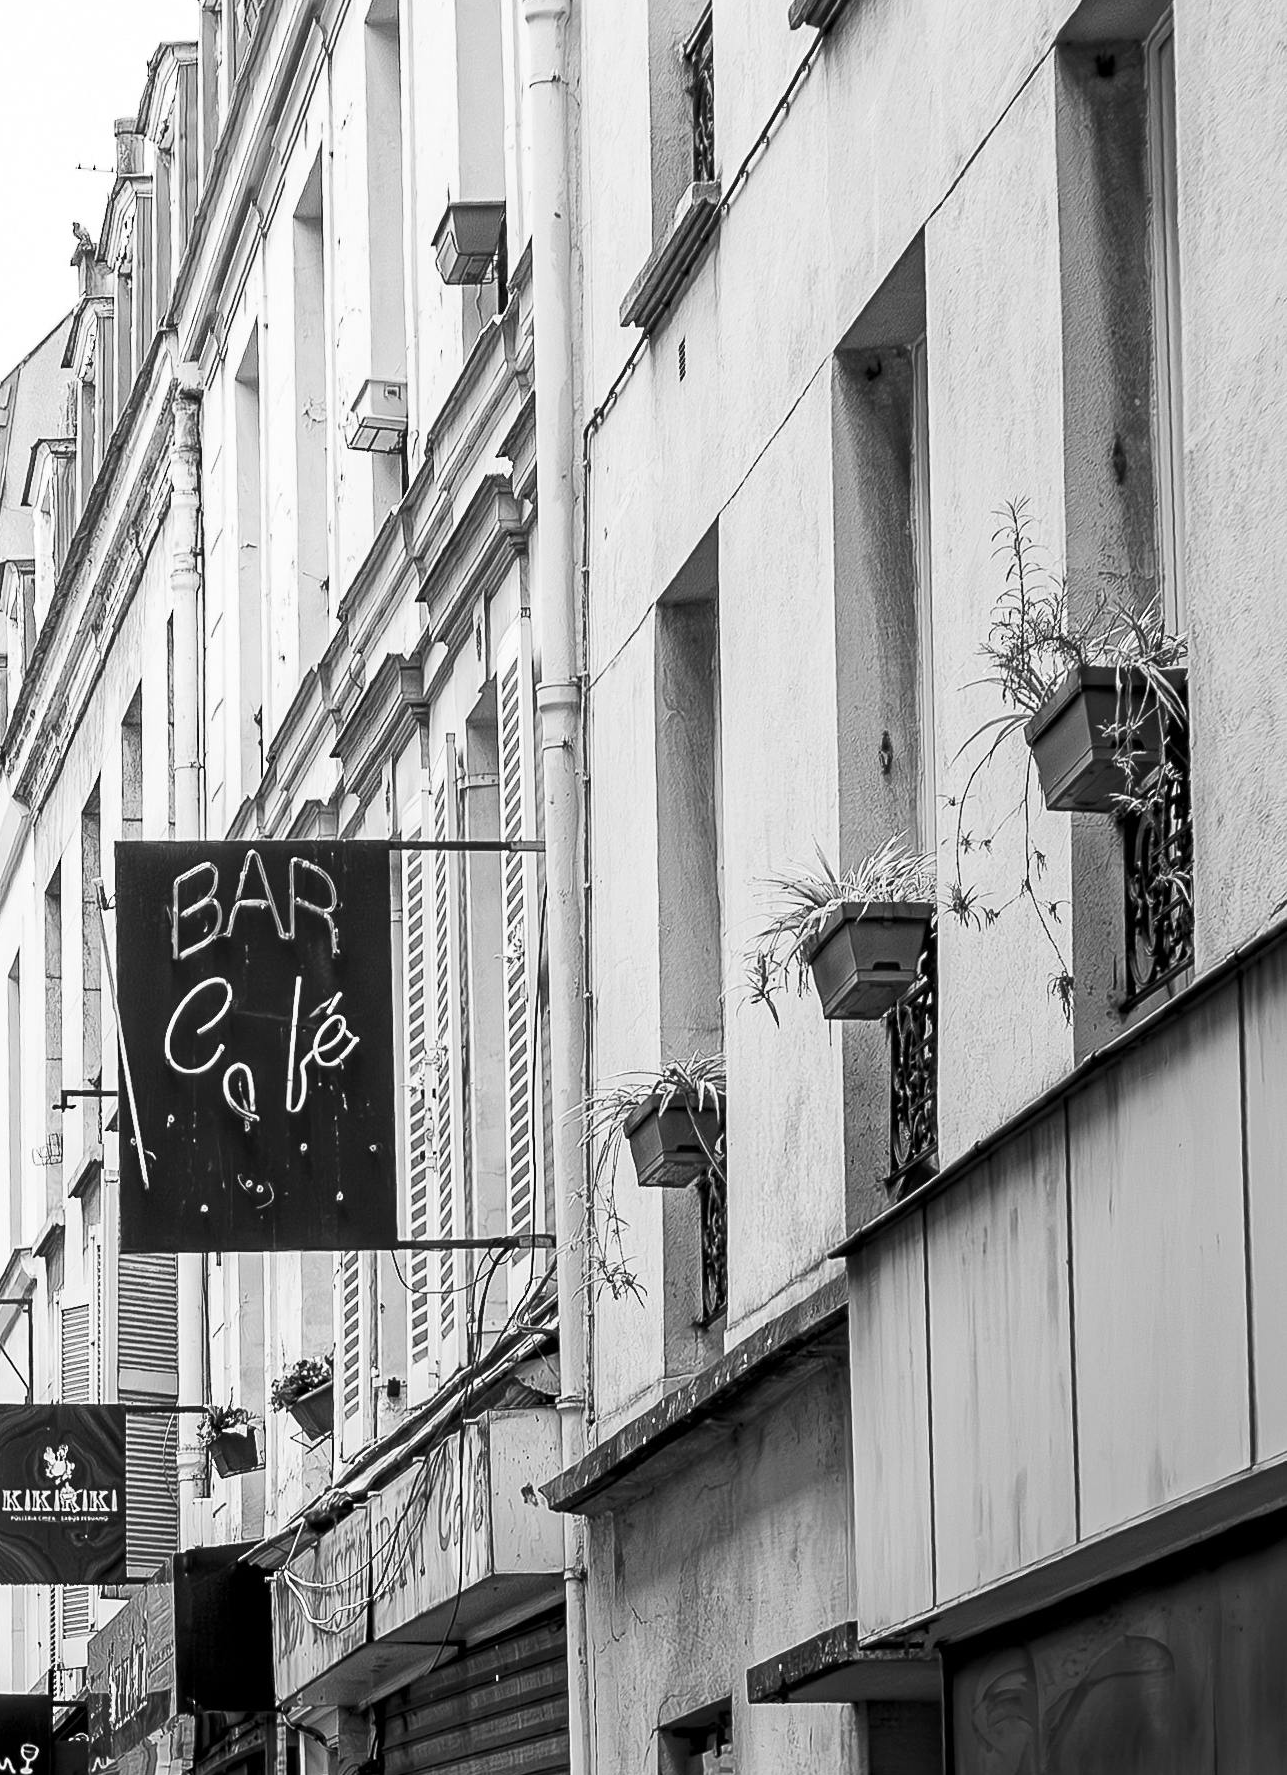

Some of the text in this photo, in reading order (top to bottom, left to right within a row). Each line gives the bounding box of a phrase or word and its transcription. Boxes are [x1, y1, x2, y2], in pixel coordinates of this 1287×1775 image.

[172, 849, 341, 960] BAR
[165, 976, 361, 1121] Café
[2, 1489, 118, 1513] KIKIRIKI
